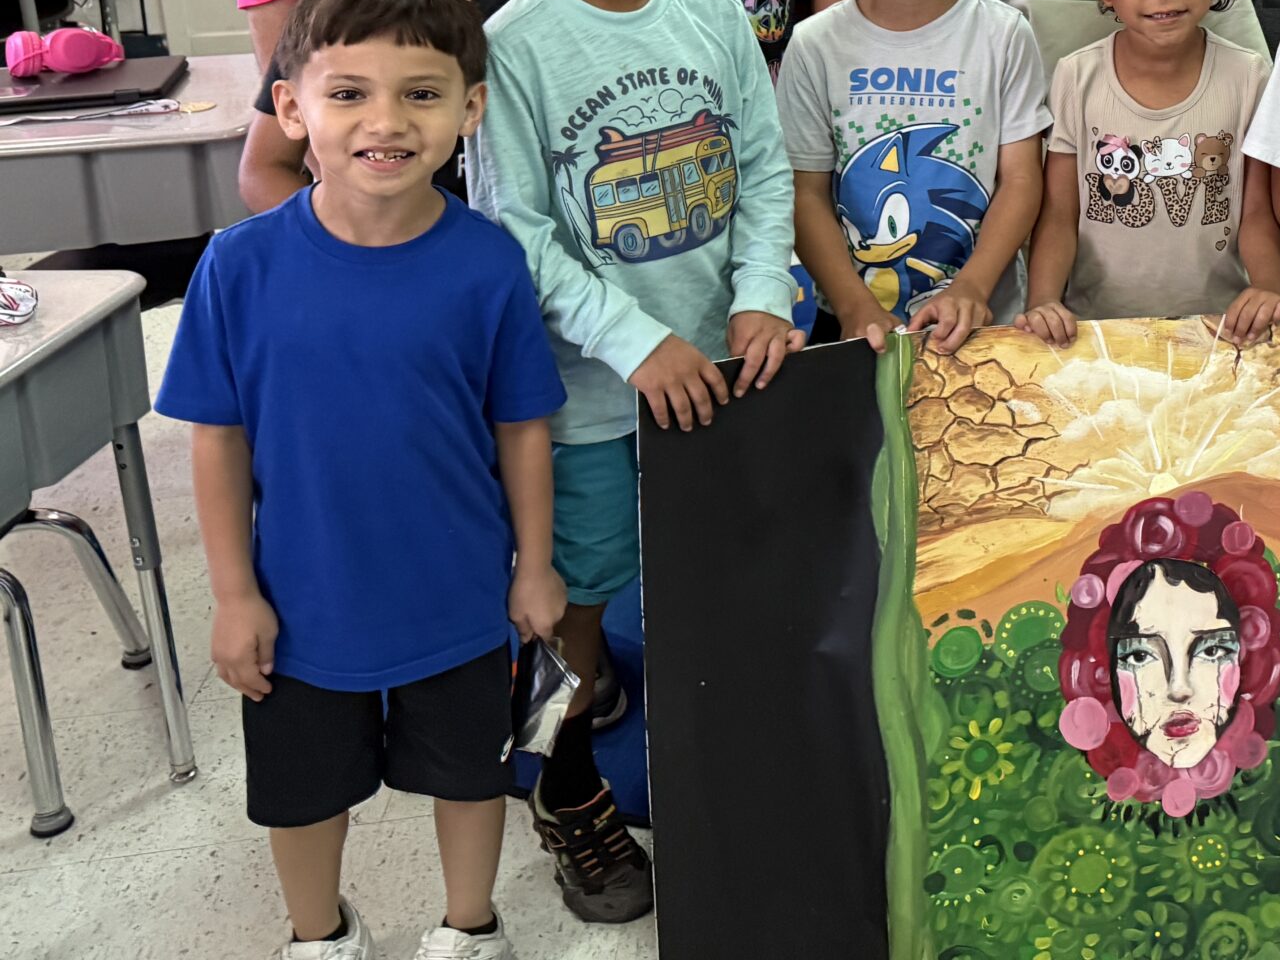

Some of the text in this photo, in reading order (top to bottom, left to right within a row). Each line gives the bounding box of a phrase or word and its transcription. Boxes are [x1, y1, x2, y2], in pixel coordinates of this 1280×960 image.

[850, 67, 957, 93] SONIC
[561, 85, 617, 141] OCEAN
[616, 67, 670, 95] STATE
[677, 67, 698, 86] OF
[850, 96, 955, 107] THE HEDGEHOG
[1085, 171, 1231, 228] LOVE
